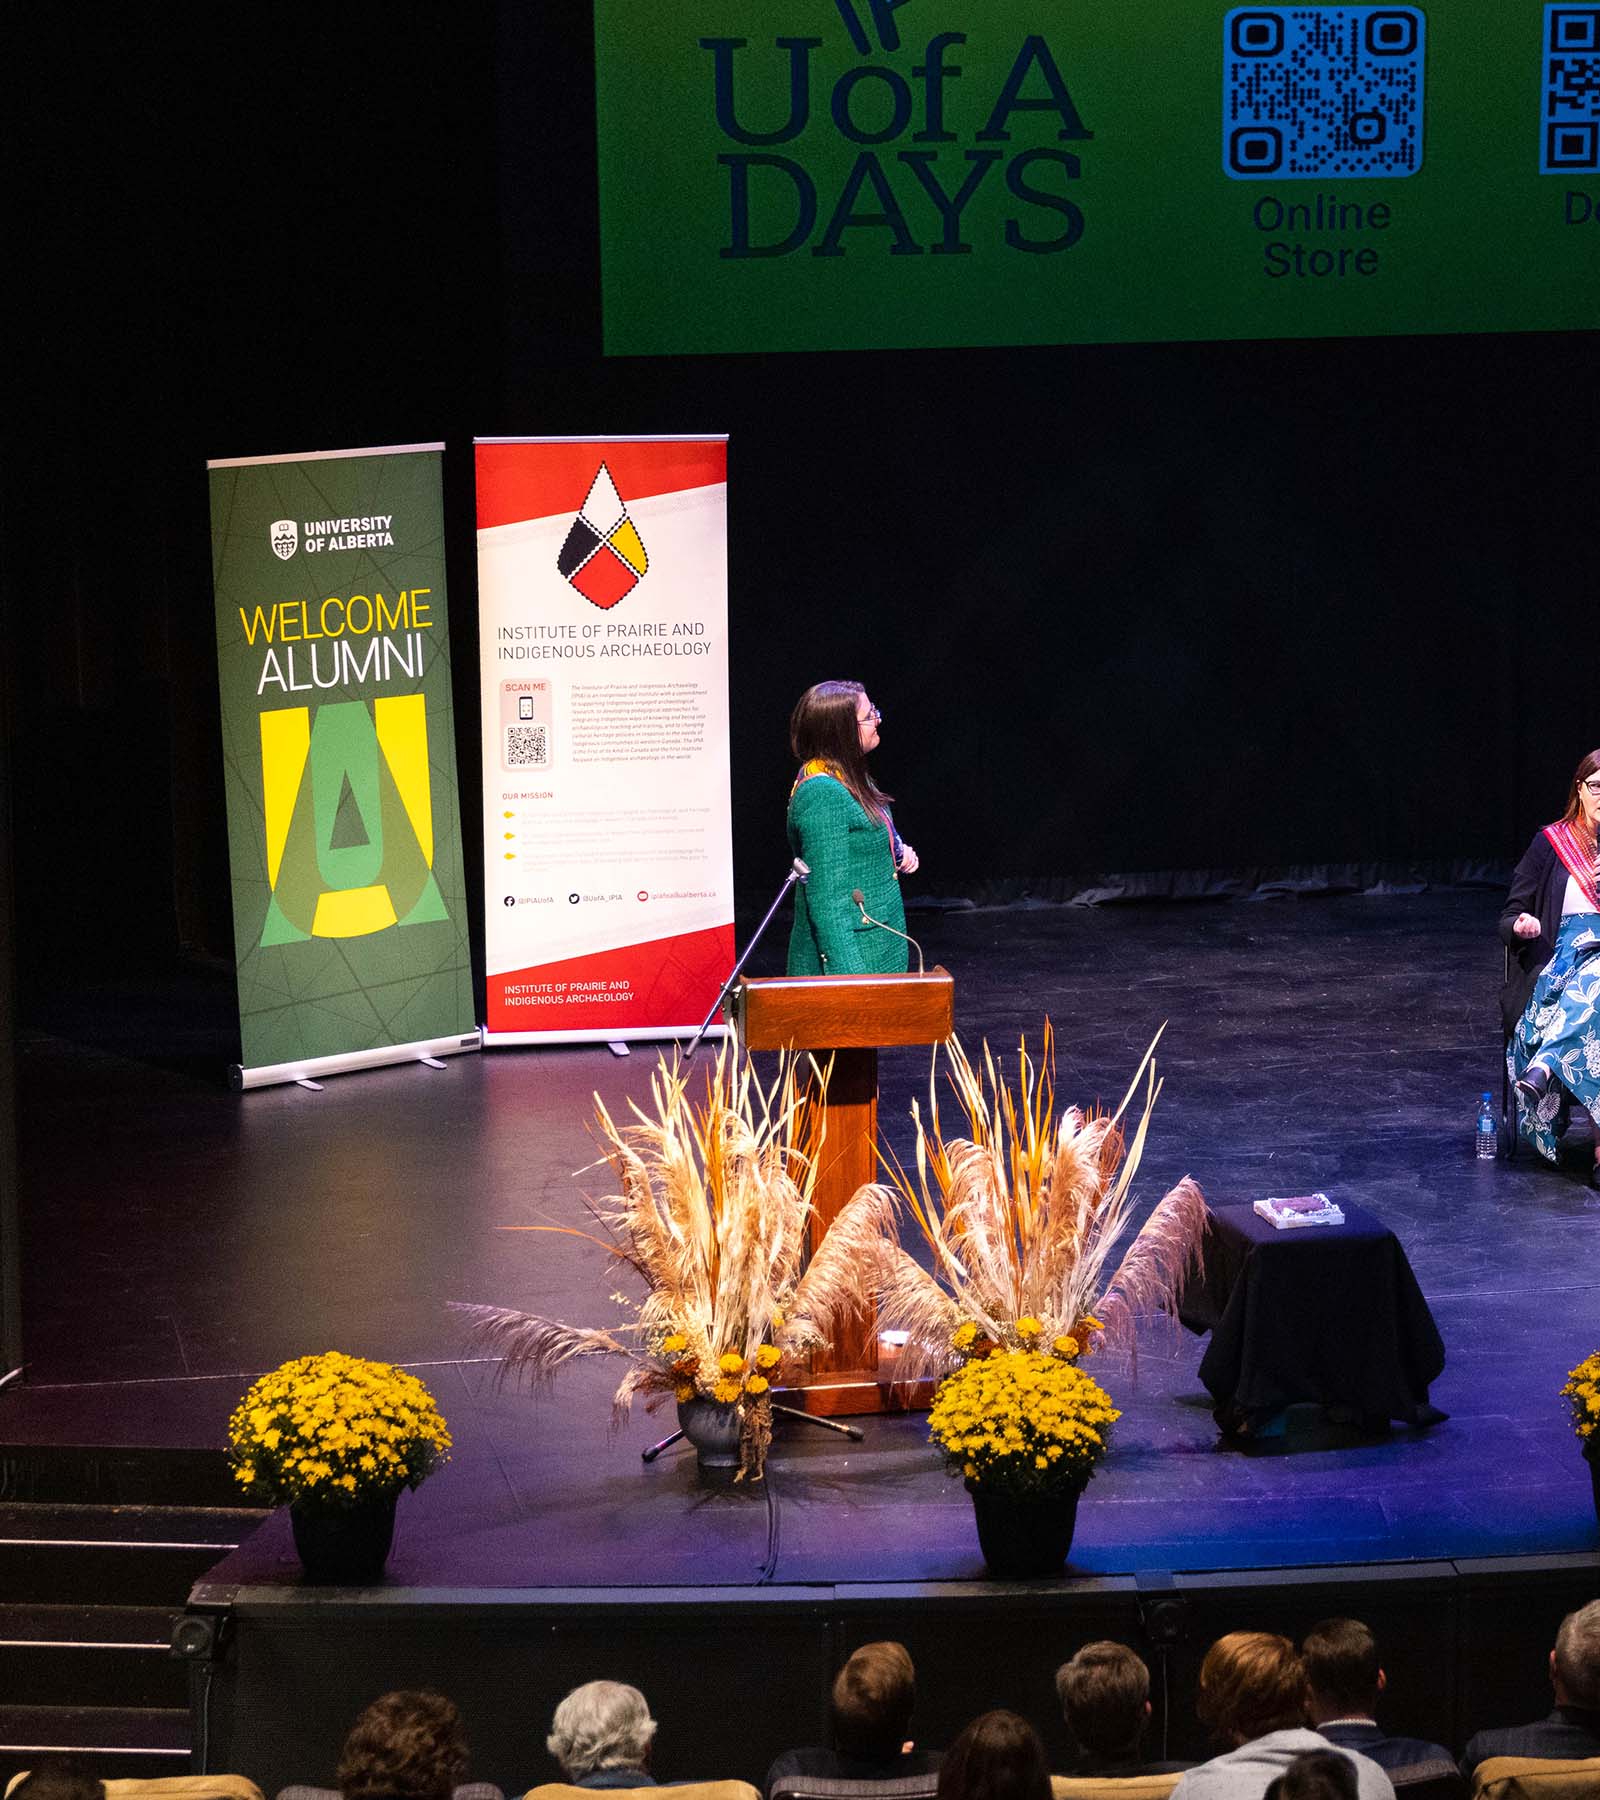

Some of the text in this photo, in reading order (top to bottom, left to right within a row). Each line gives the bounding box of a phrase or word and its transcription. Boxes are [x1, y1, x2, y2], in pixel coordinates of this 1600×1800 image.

[717, 147, 1085, 259] DAYS
[1252, 193, 1394, 233] Online
[1262, 240, 1380, 279] Store
[304, 515, 394, 536] UNIVERSITY
[305, 531, 395, 553] OF ALBERTA
[238, 587, 433, 646] WELCOME
[498, 622, 705, 640] INSTITUTE OF PRAIRIE AND
[498, 641, 712, 660] INDIGENOUS ARCHAEOLOGY
[256, 632, 424, 696] ALUMNI
[505, 682, 546, 692] SCAN ME
[502, 791, 554, 801] OUR MISSION
[504, 980, 630, 994] INSTITUTE OF PRAIRIE AND
[504, 992, 635, 1006] INDIGENOUS ARCHAEOLOGY
